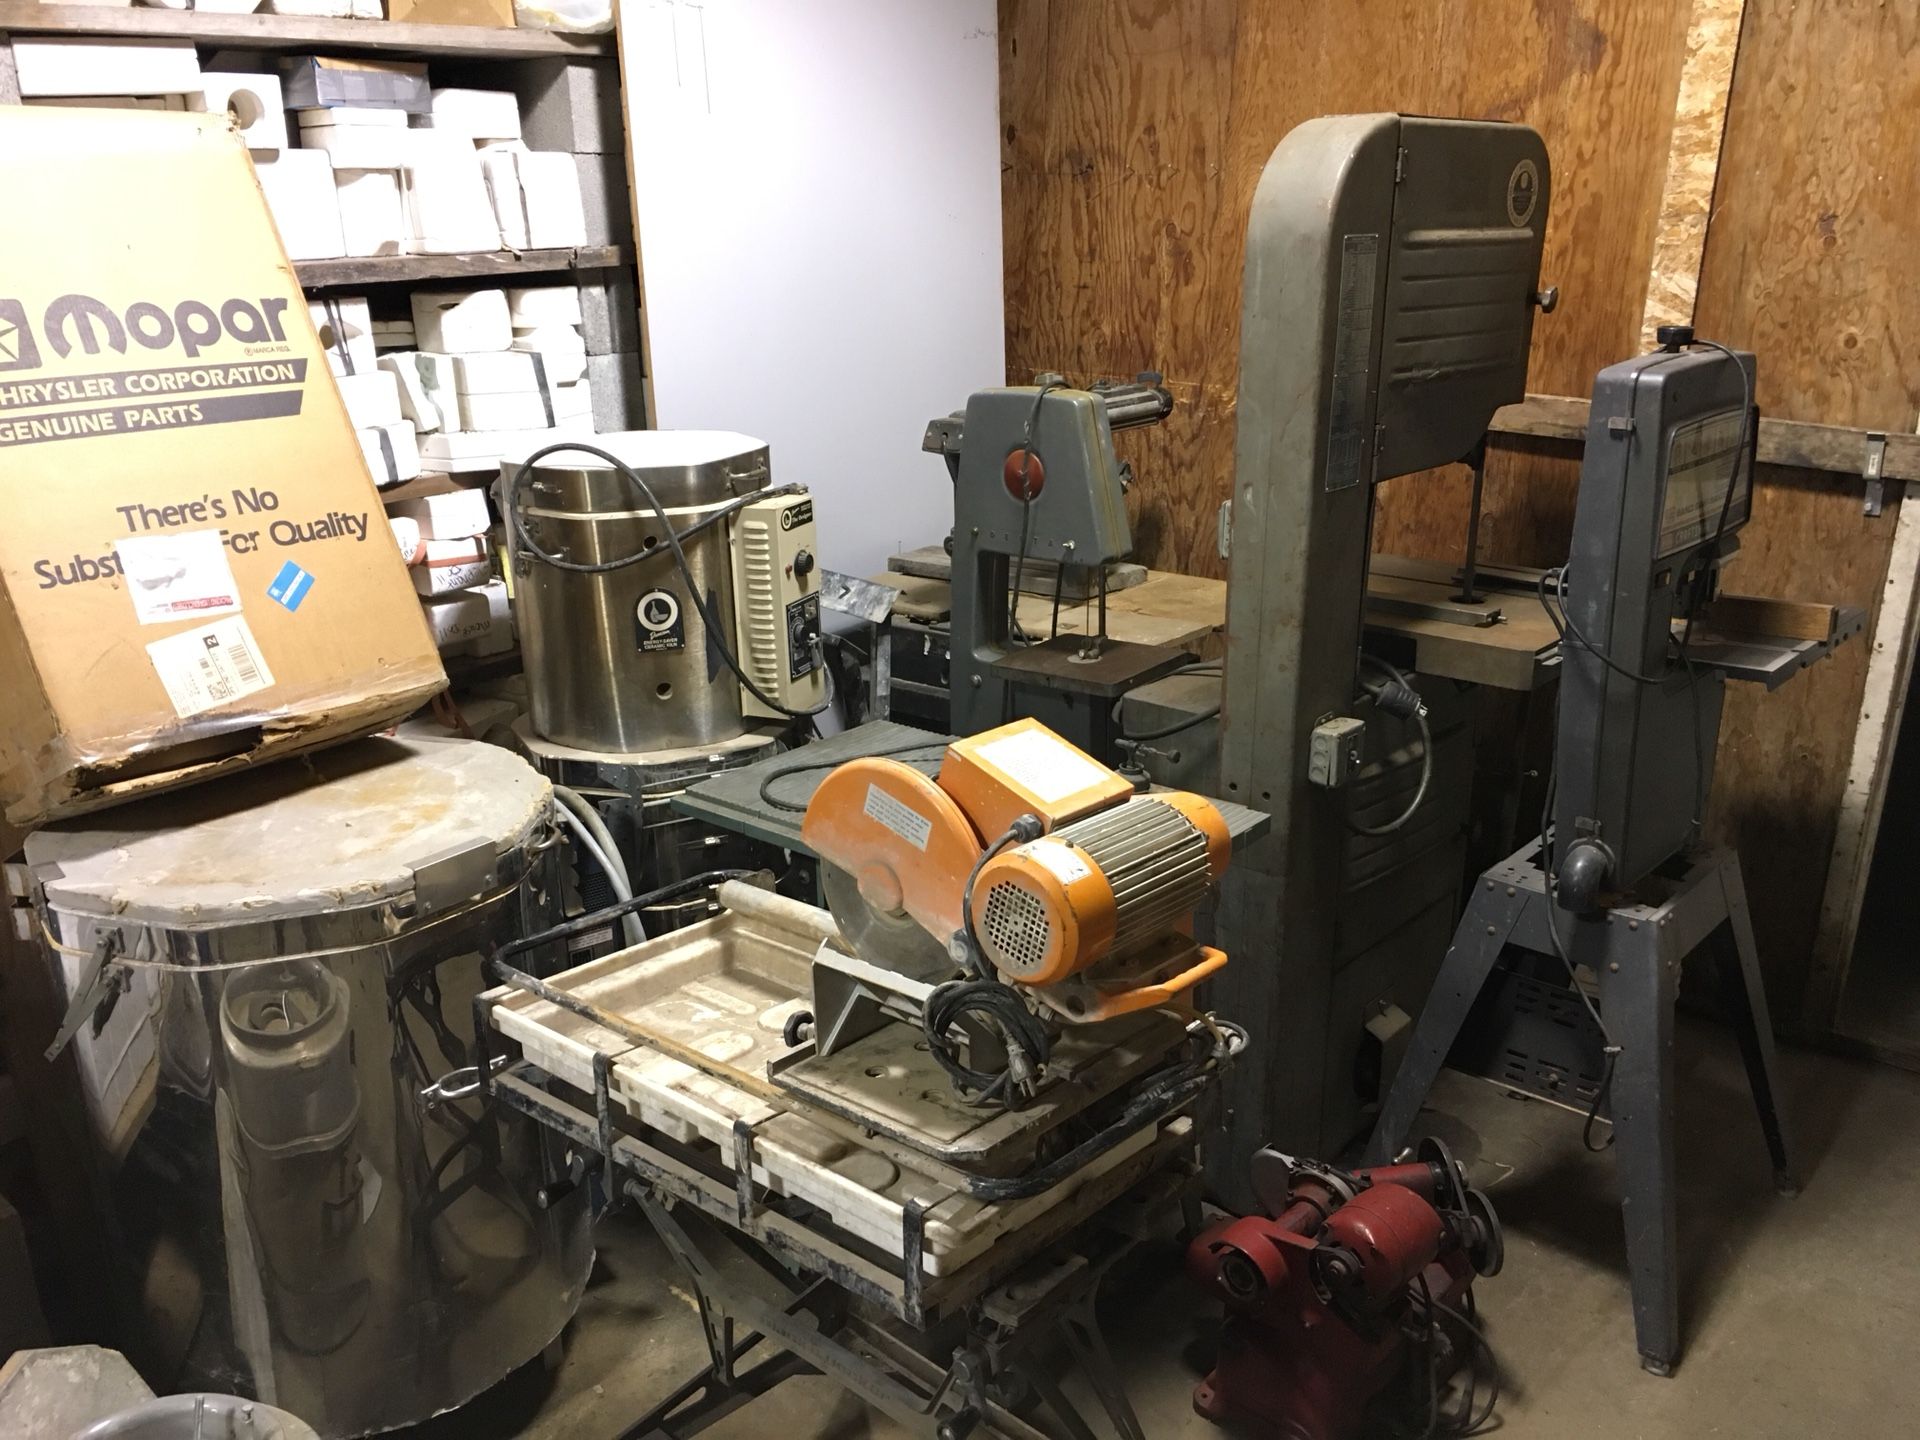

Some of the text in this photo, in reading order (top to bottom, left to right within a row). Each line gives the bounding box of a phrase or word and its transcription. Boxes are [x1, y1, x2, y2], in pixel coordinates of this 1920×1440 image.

[0, 363, 297, 406] HRYSLER CORPORATION
[0, 403, 204, 442] GENUINE PARTS
[116, 487, 279, 533] There's No
[34, 550, 125, 590] Subst
[269, 512, 369, 547] Quality
